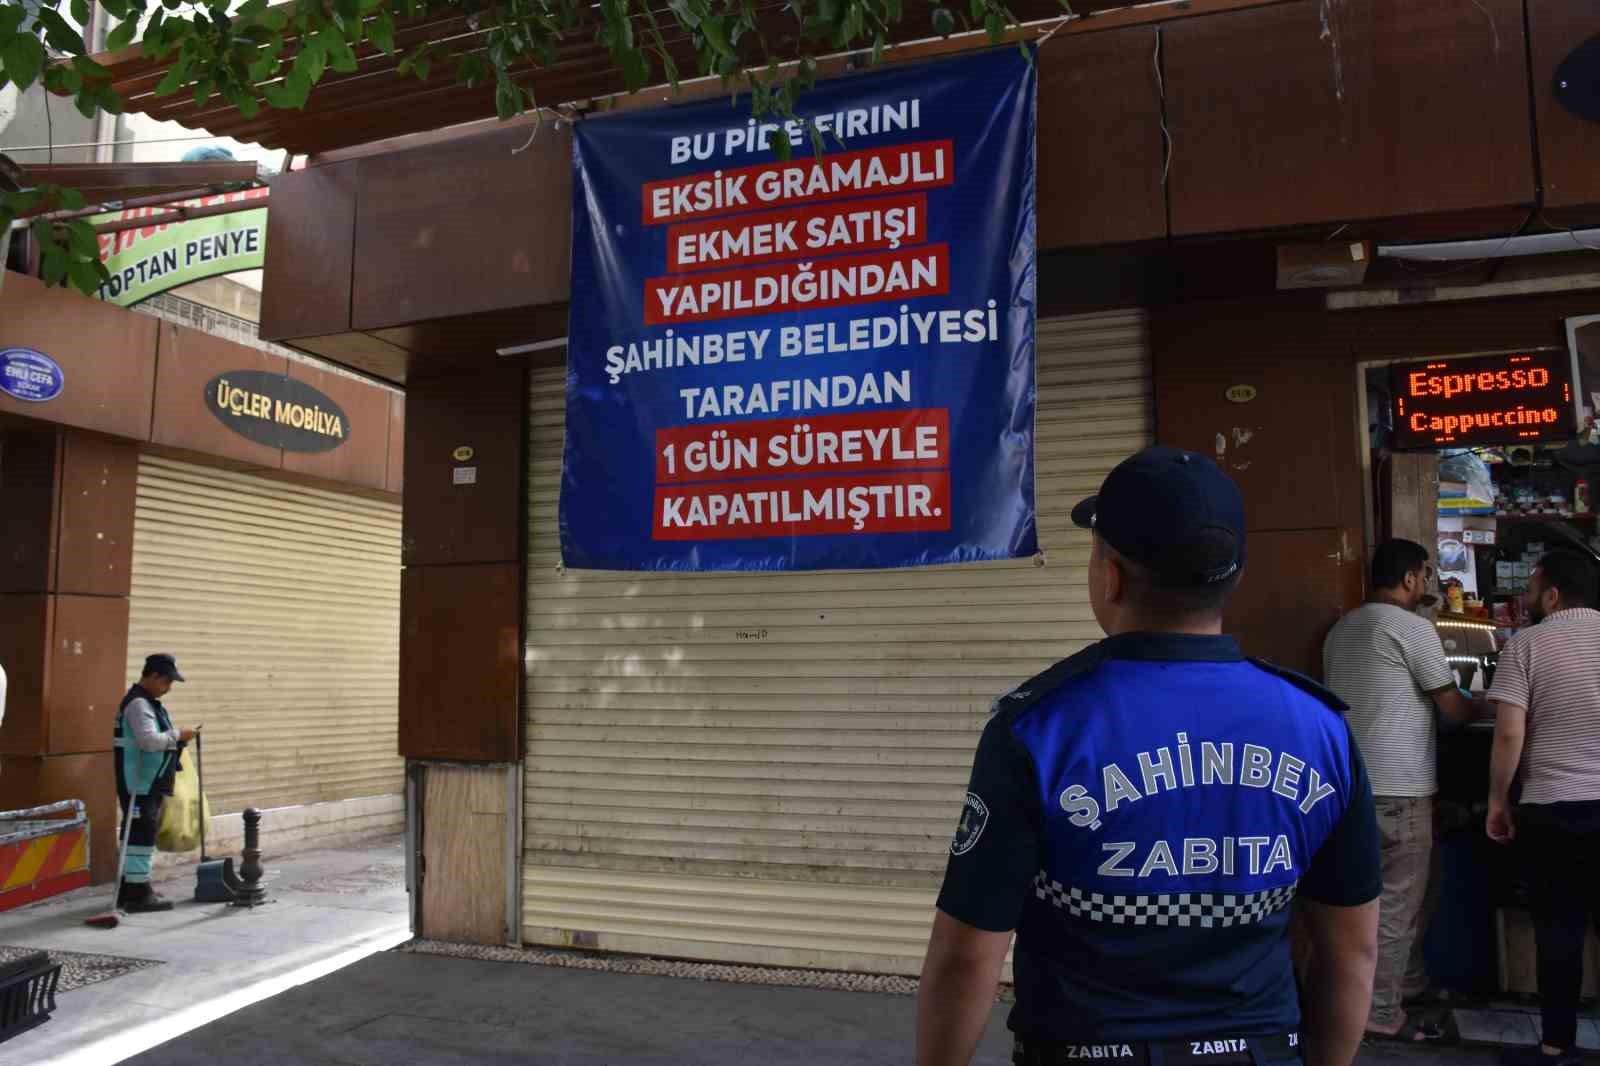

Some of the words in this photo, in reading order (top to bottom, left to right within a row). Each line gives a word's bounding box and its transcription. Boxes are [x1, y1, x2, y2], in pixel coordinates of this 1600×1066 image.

[670, 133, 715, 165] BU
[725, 117, 804, 156] PİDE
[815, 98, 920, 138] FIRINI
[651, 171, 747, 219] EKSİK
[755, 149, 945, 201] GRAMAJLI
[677, 220, 798, 265] EKMEK
[806, 206, 916, 249] SATIŞI
[98, 247, 178, 302] TOPTAN
[186, 228, 259, 268] PENYE
[657, 256, 937, 317] YAPILDIĞINDAN
[604, 329, 770, 384] ŞAHİNBEY
[780, 299, 998, 358] BELEDİYESİ
[217, 379, 272, 420] ÜÇLER
[274, 399, 343, 438] MOBİLYA
[680, 370, 911, 418] TARAFINDAN
[1410, 368, 1548, 398] Espresso
[1410, 405, 1557, 433] Cappuccino
[662, 443, 676, 475] 1
[684, 431, 758, 473] GÜN
[767, 424, 939, 467] SÜREYLE
[662, 484, 942, 530] KAPATILMIŞTIR.
[1059, 732, 1335, 831] ŞAHİNBEY
[1097, 834, 1293, 878] ZABITA
[1067, 1044, 1133, 1059] ZABITA
[1190, 1038, 1247, 1055] ZABITA
